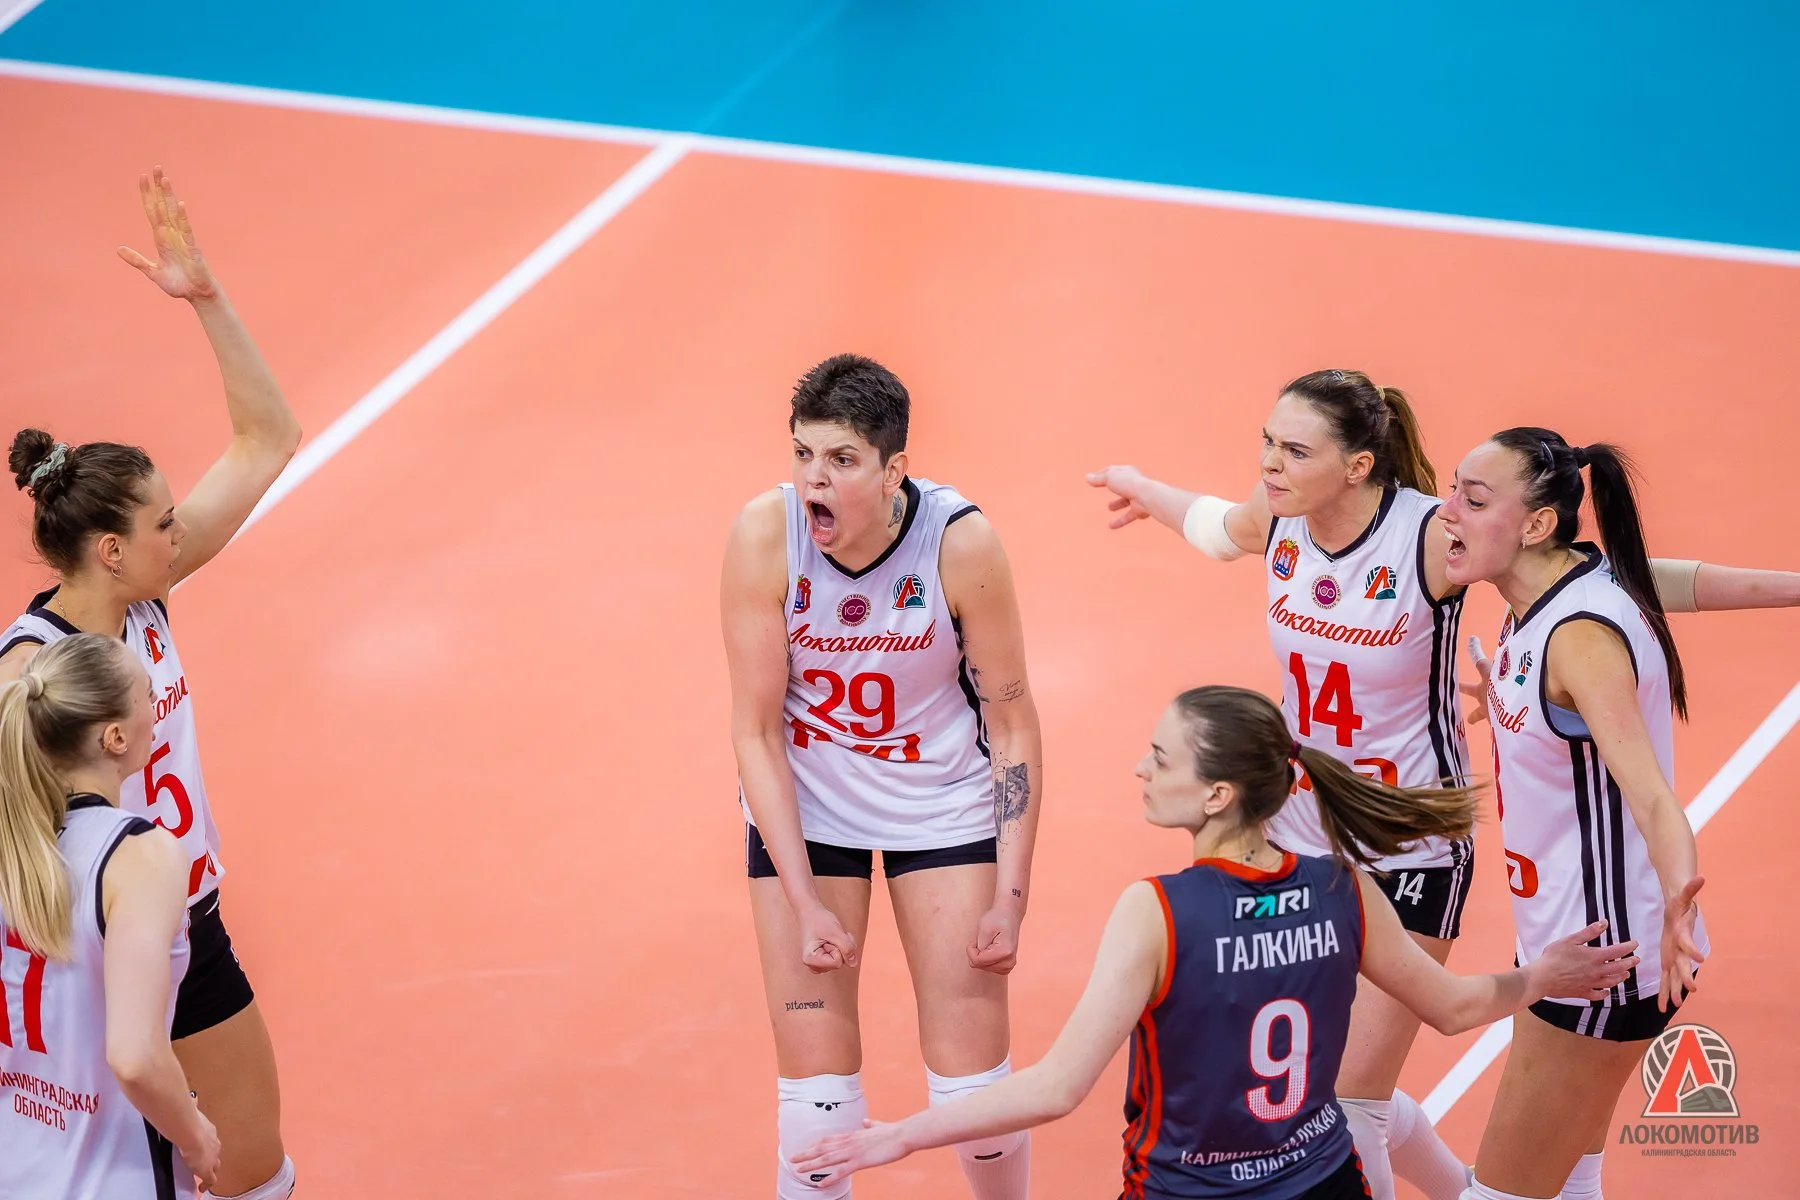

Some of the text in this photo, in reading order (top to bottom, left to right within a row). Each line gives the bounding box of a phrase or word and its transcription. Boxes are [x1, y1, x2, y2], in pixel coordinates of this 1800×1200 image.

[1269, 593, 1409, 647] Локомотив
[802, 668, 895, 739] 29
[1288, 651, 1362, 748] 14
[1393, 872, 1425, 906] 14
[1215, 919, 1340, 974] ГАЛКИНА
[785, 999, 825, 1011] pitoresk
[1245, 998, 1311, 1122] 9
[0, 1066, 99, 1115] ИНИНГРАДСКАЯ
[14, 1093, 66, 1132] ОБЛАСТЬ
